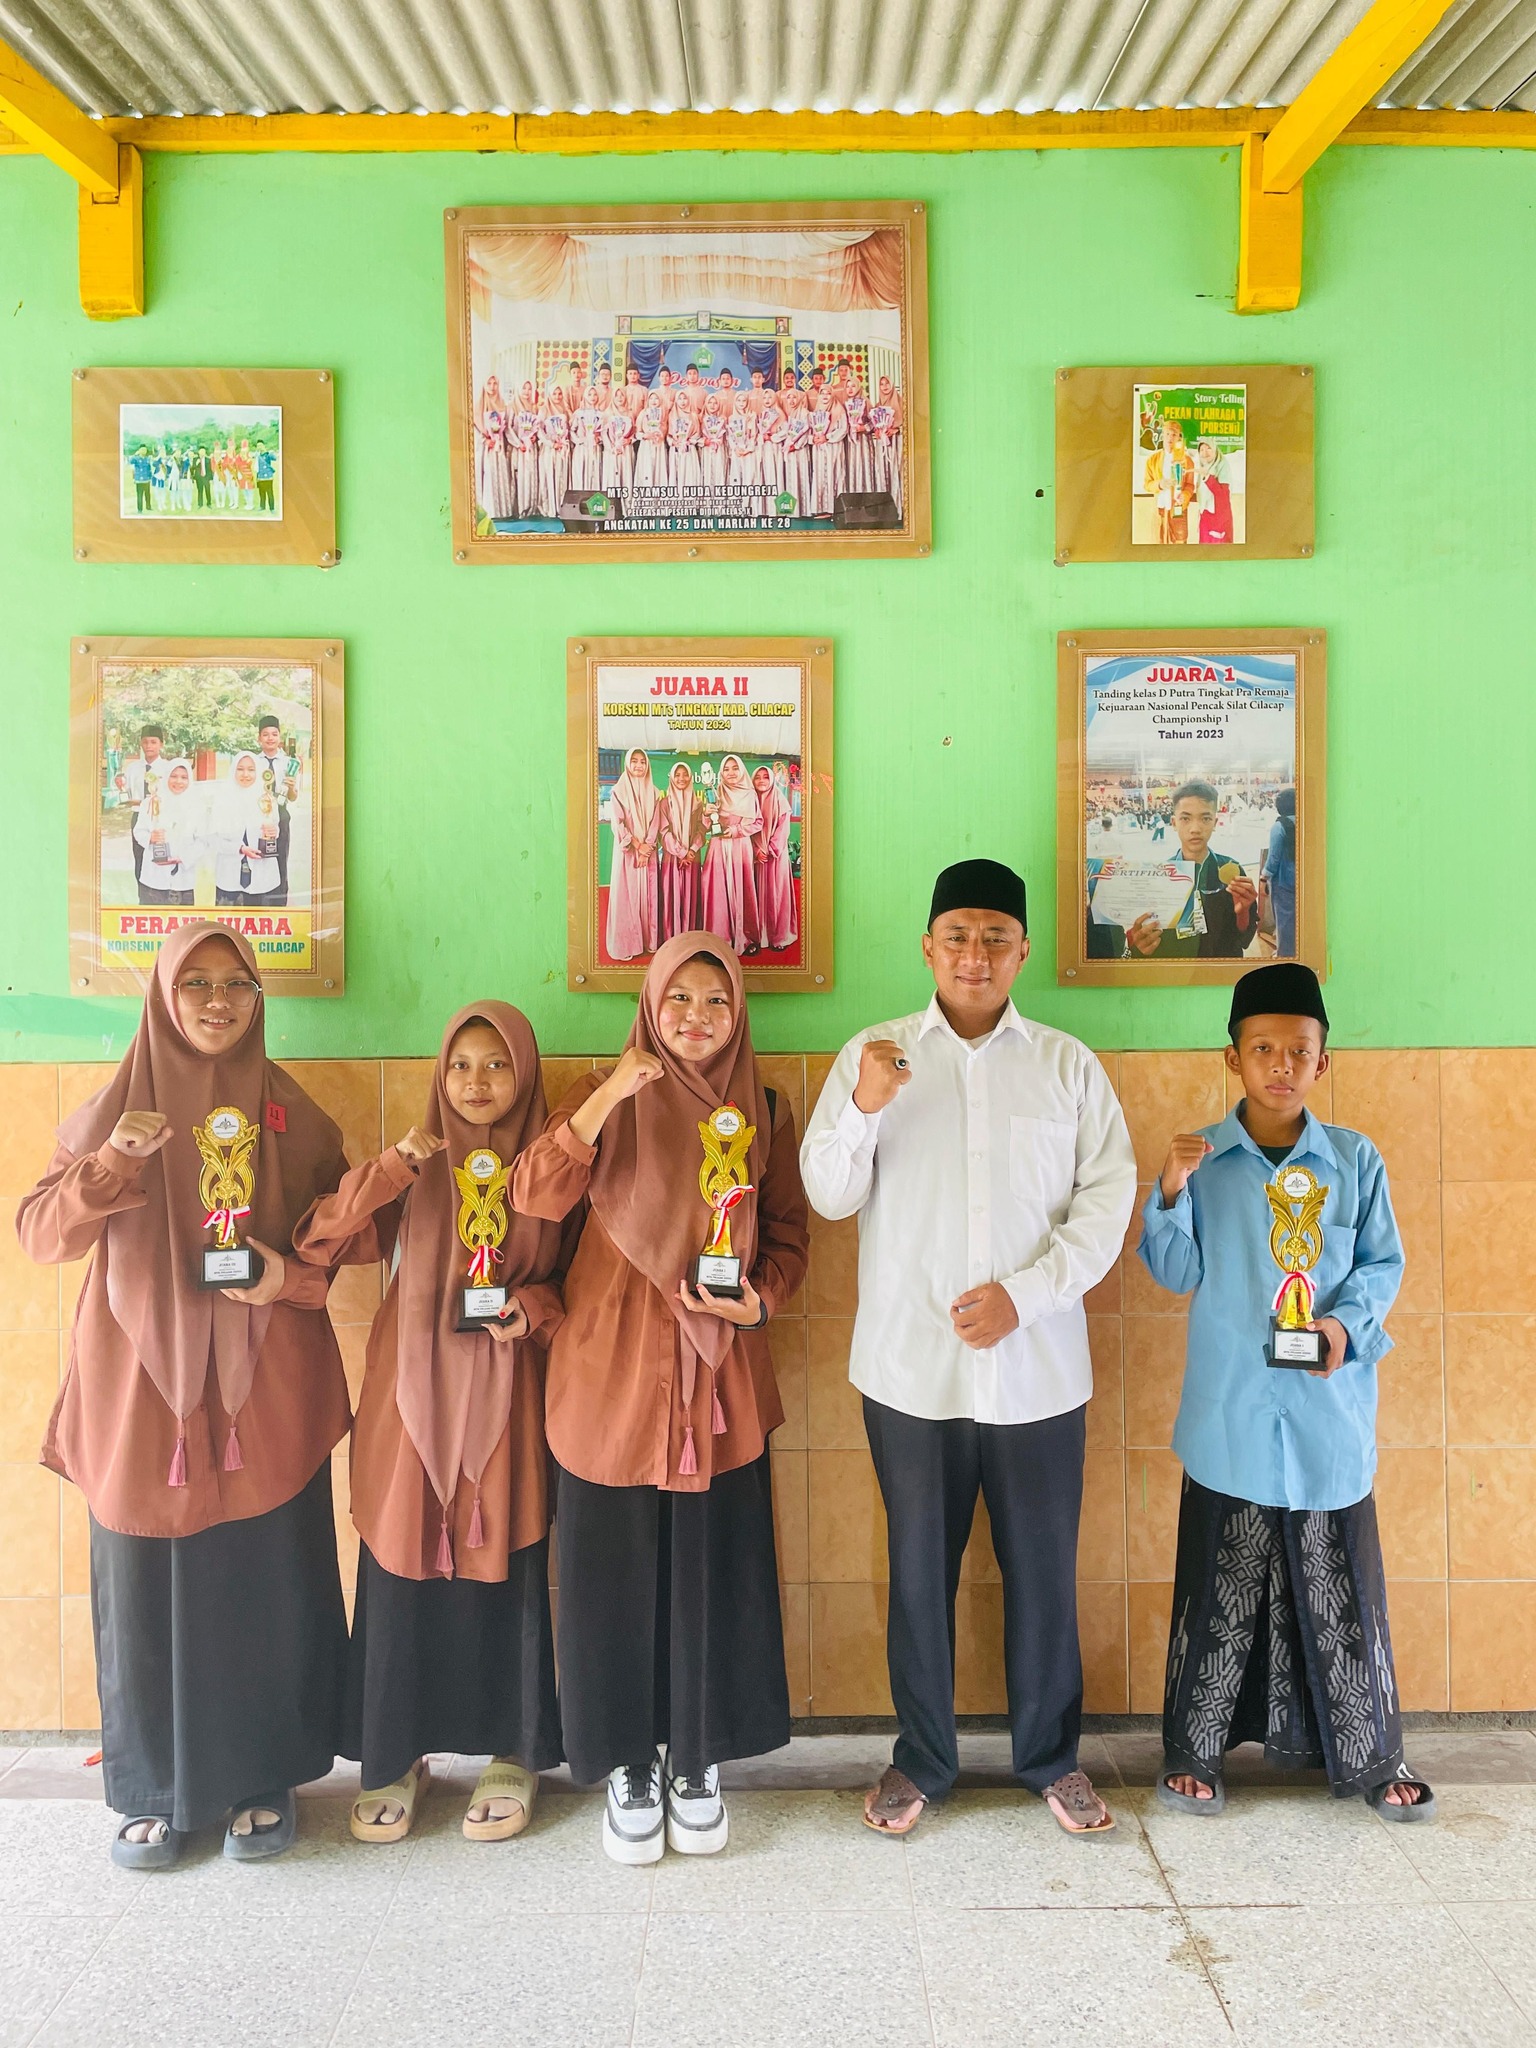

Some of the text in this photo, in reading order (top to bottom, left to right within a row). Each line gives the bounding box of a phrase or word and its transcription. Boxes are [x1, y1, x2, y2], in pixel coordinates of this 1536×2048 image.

[1194, 393, 1217, 404] Story
[1164, 407, 1191, 419] PEKAN
[1194, 407, 1236, 421] OLAHRAGA
[607, 485, 778, 498] MTS SYAMSUL HUDA KEDUNGREJA
[627, 508, 666, 517] PELEPASAN
[668, 508, 697, 516] PESERTA
[699, 507, 720, 516] DIDIK
[721, 507, 743, 516] KELAS
[604, 518, 791, 531] ANGKATAN KE 25 DAN HARLAH KE 28
[1147, 667, 1235, 683] JUARA 1
[650, 677, 749, 696] JUARA II
[1093, 688, 1289, 702] Tanding kelas D Putra Tingkat Pra Remaja
[603, 703, 796, 717] KORSENI MTs TINGKAT KAB. CILACAP
[1098, 701, 1285, 713] Kejuaraan Nasional Pencak Silat Cilacap
[668, 720, 731, 730] TAHUN 2024
[1152, 715, 1222, 726] Championship
[1158, 730, 1224, 740] Tahun 2023
[121, 916, 206, 934] PERA
[107, 940, 154, 952] KORSENI
[258, 942, 305, 953] CILACAP
